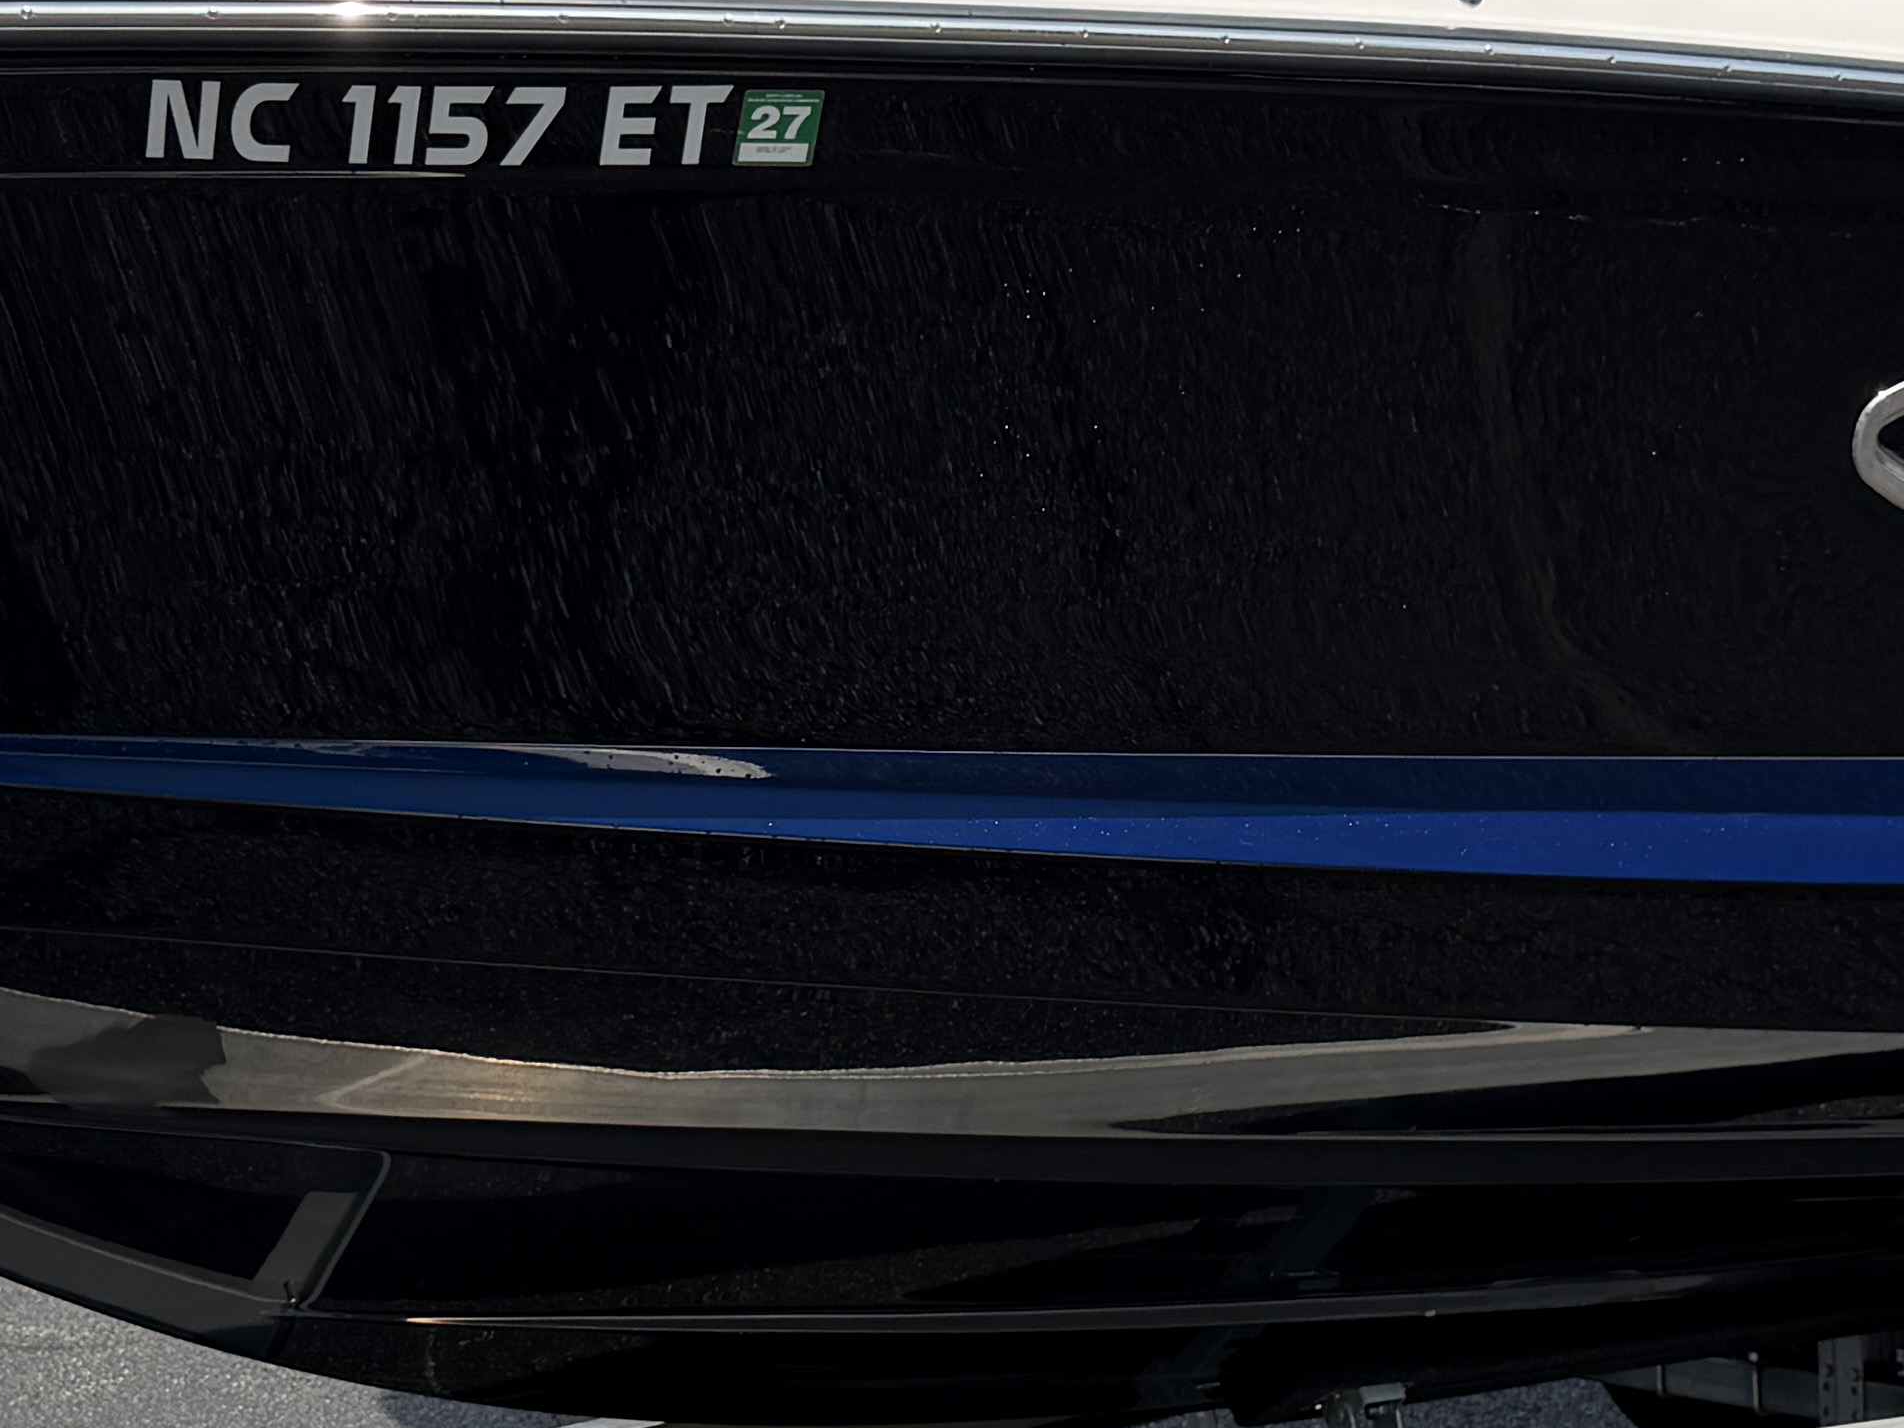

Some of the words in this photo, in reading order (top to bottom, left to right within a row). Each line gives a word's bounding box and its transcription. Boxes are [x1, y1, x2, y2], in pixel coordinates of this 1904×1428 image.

[145, 79, 300, 163] NC
[342, 84, 568, 166] 1157
[599, 84, 735, 166] ET
[746, 104, 813, 141] 27
